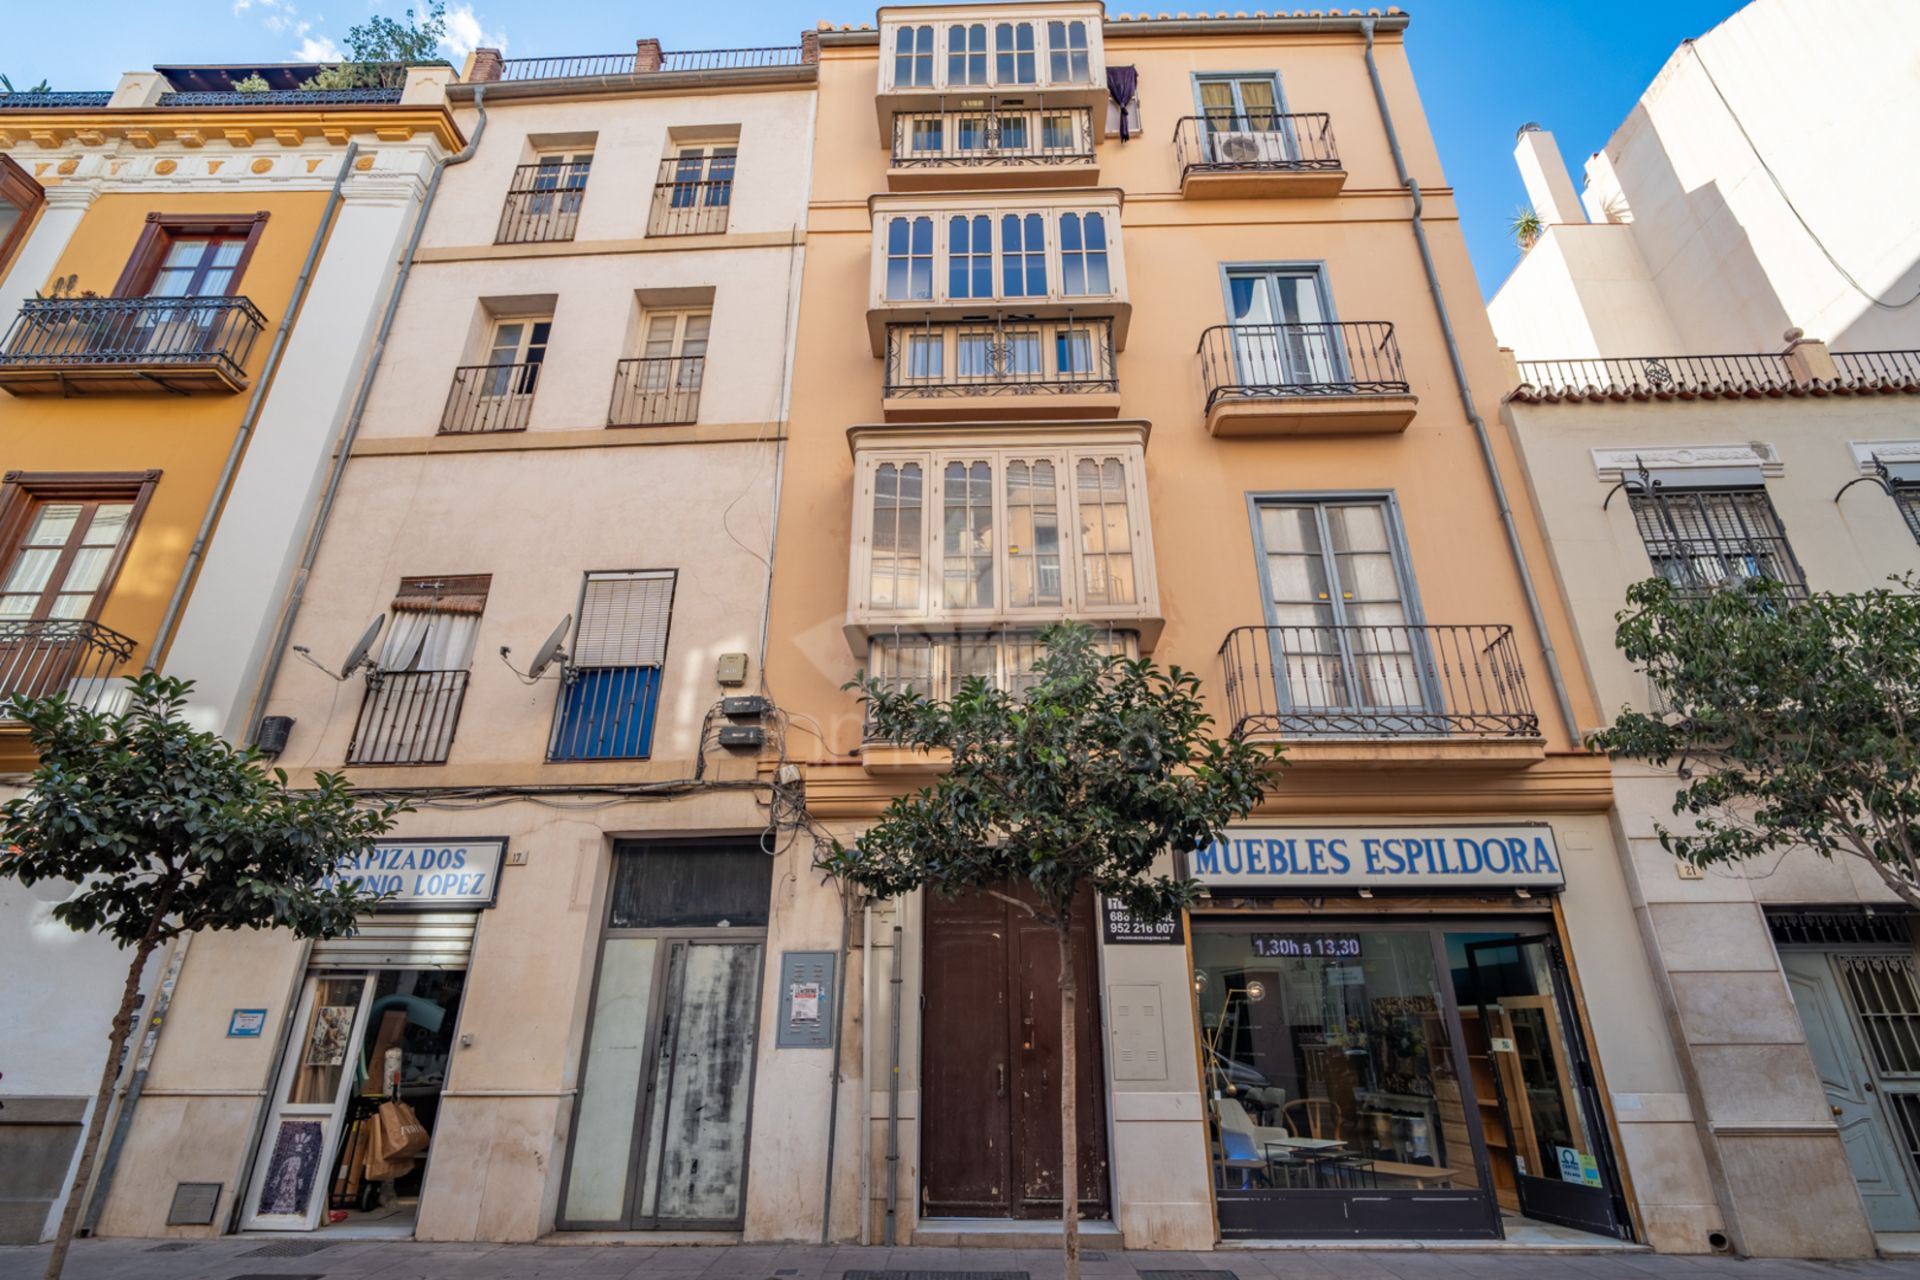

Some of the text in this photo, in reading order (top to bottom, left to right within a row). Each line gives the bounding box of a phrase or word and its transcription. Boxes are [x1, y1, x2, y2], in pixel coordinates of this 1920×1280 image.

[512, 852, 522, 863] 17
[1195, 837, 1558, 875] MUEBLES ESPILDORA
[413, 873, 486, 896] LOPEZ
[1110, 923, 1175, 934] 952 216 007
[1303, 943, 1312, 955] a
